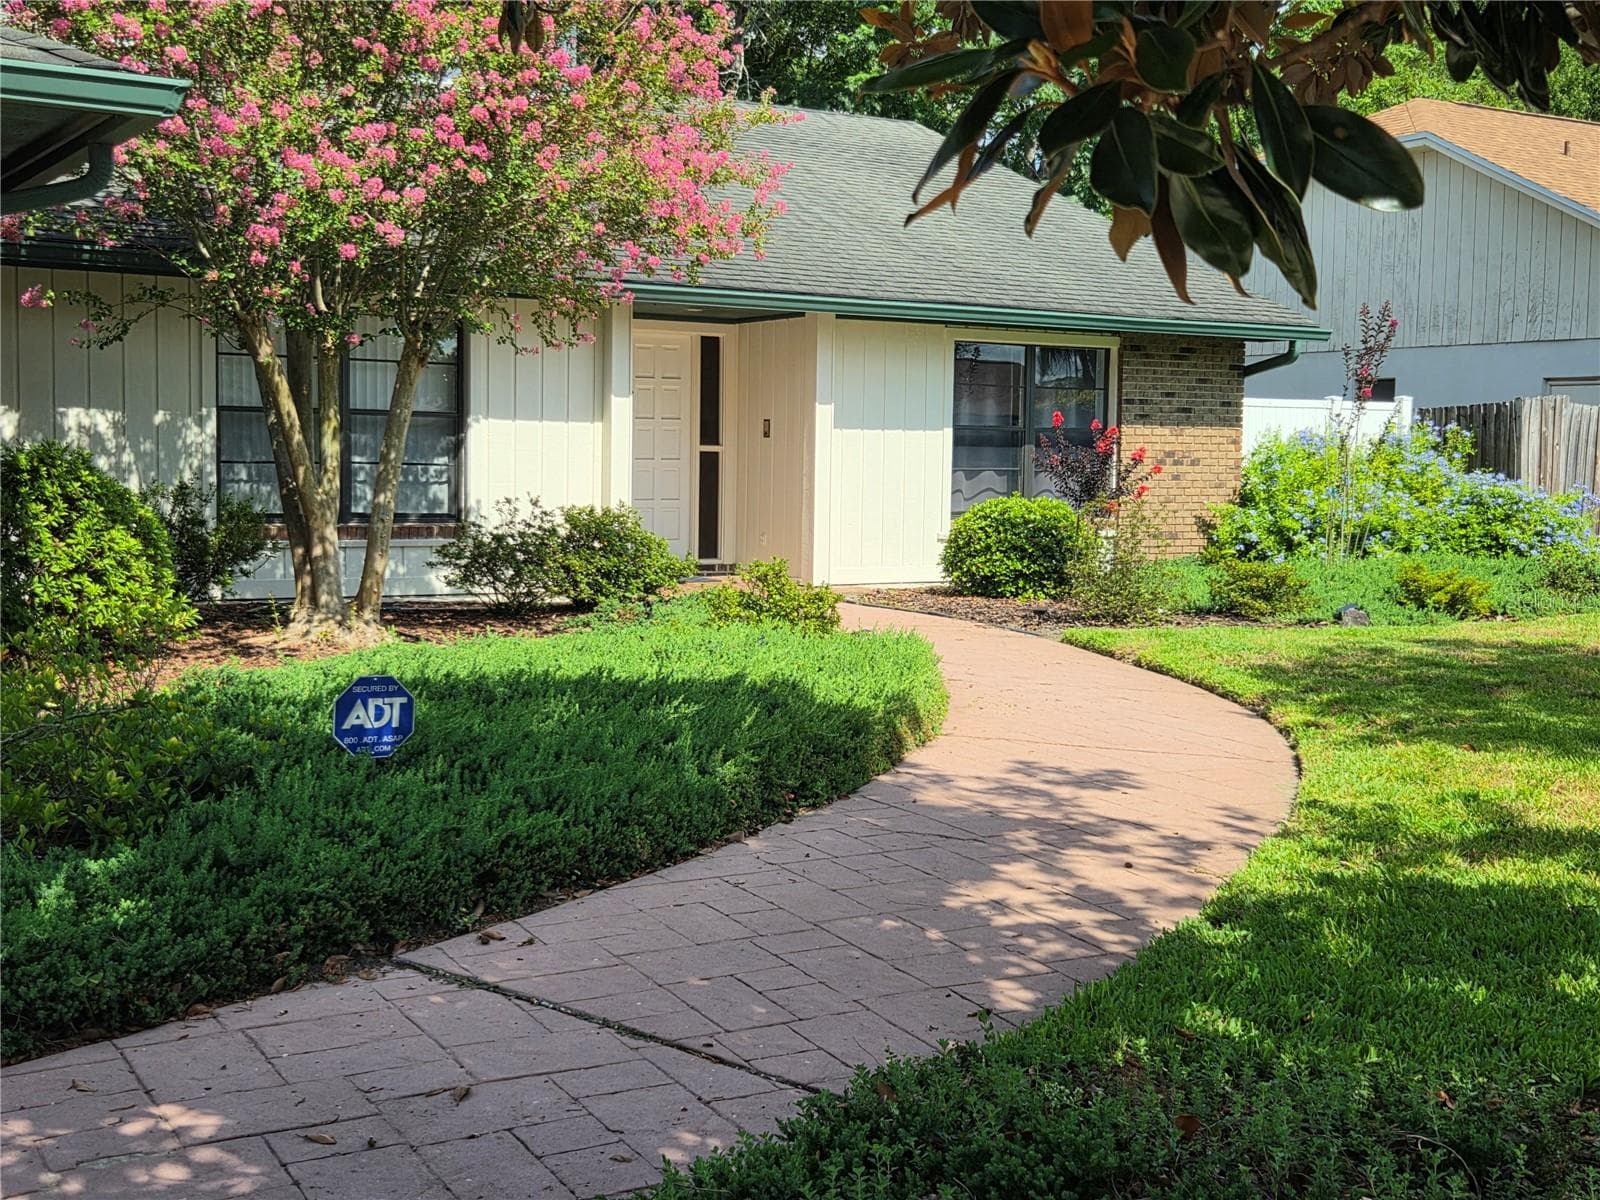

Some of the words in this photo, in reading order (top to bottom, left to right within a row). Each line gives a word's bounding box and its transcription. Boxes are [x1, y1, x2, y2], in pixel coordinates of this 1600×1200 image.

[352, 685, 387, 693] SECURED
[388, 684, 399, 692] BY
[341, 696, 408, 729] ADT
